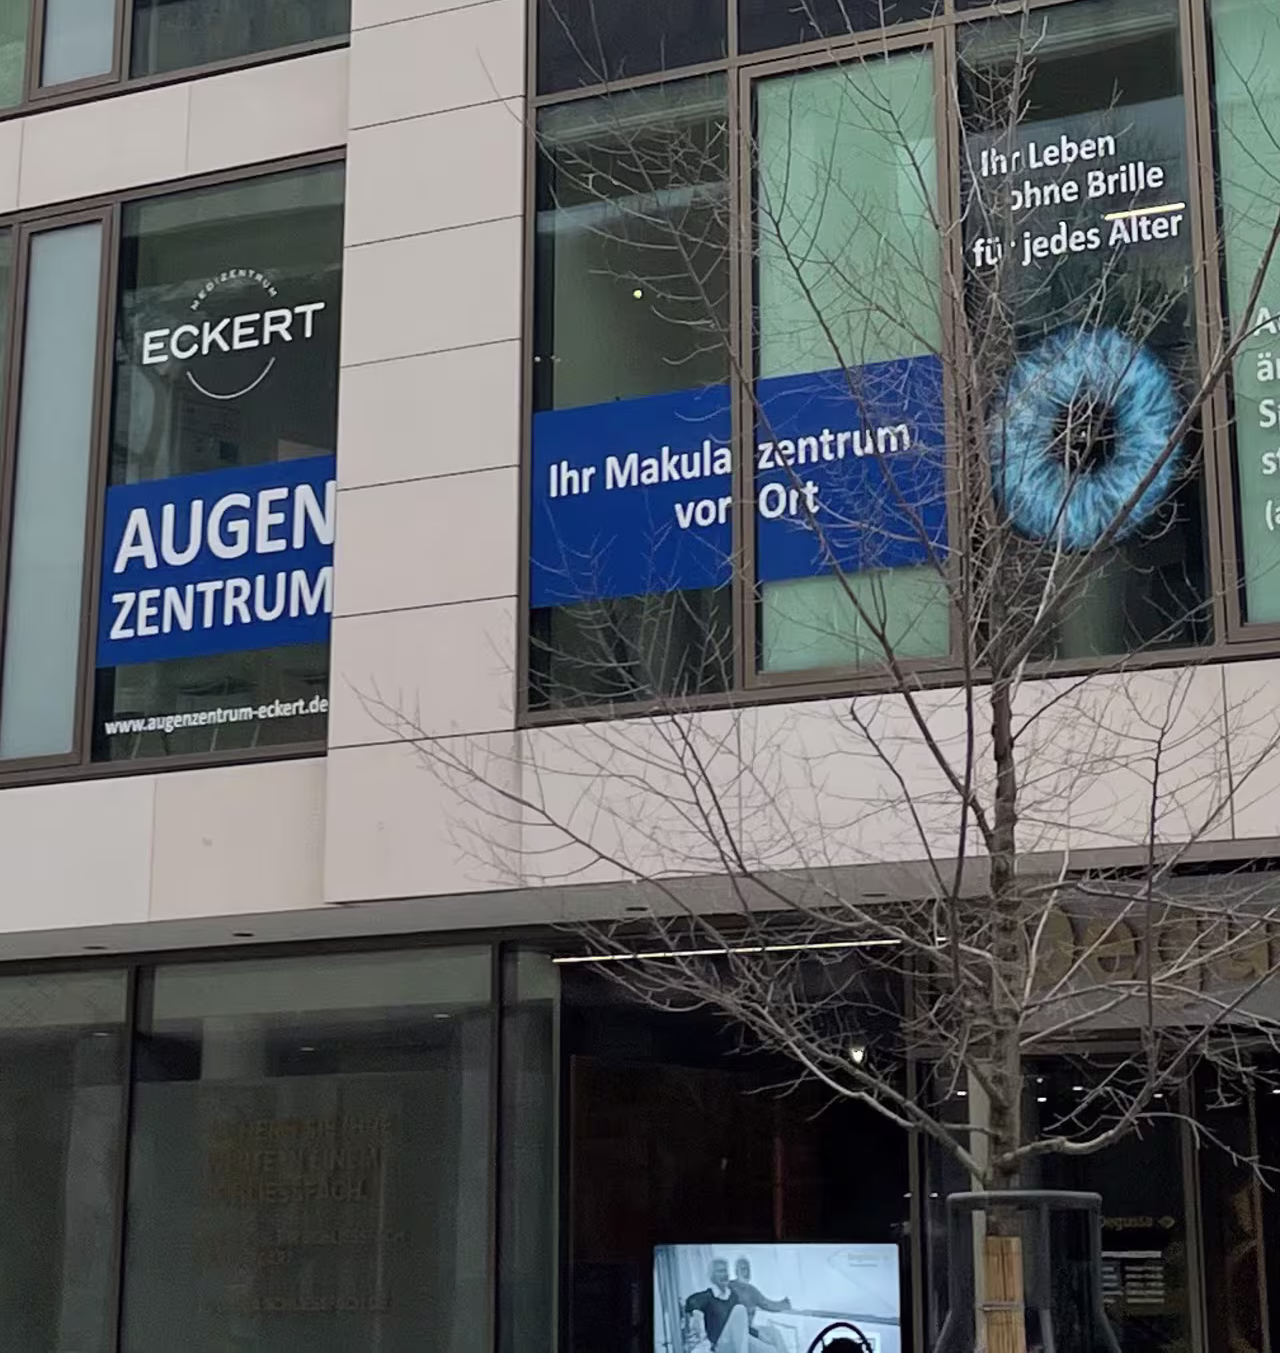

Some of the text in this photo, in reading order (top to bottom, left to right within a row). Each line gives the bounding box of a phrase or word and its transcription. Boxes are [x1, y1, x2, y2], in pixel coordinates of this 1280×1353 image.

[1029, 135, 1115, 169] Leben
[1087, 161, 1164, 199] Brille
[973, 211, 1183, 267] fü jedes Alter
[142, 302, 325, 365] ECKERT
[549, 463, 596, 498] Ihr
[674, 480, 820, 529] vor Ort
[113, 480, 337, 574] AUGEN
[110, 566, 333, 640] ZENTRUM
[105, 695, 329, 735] www.augenzentrum-eckert.de
